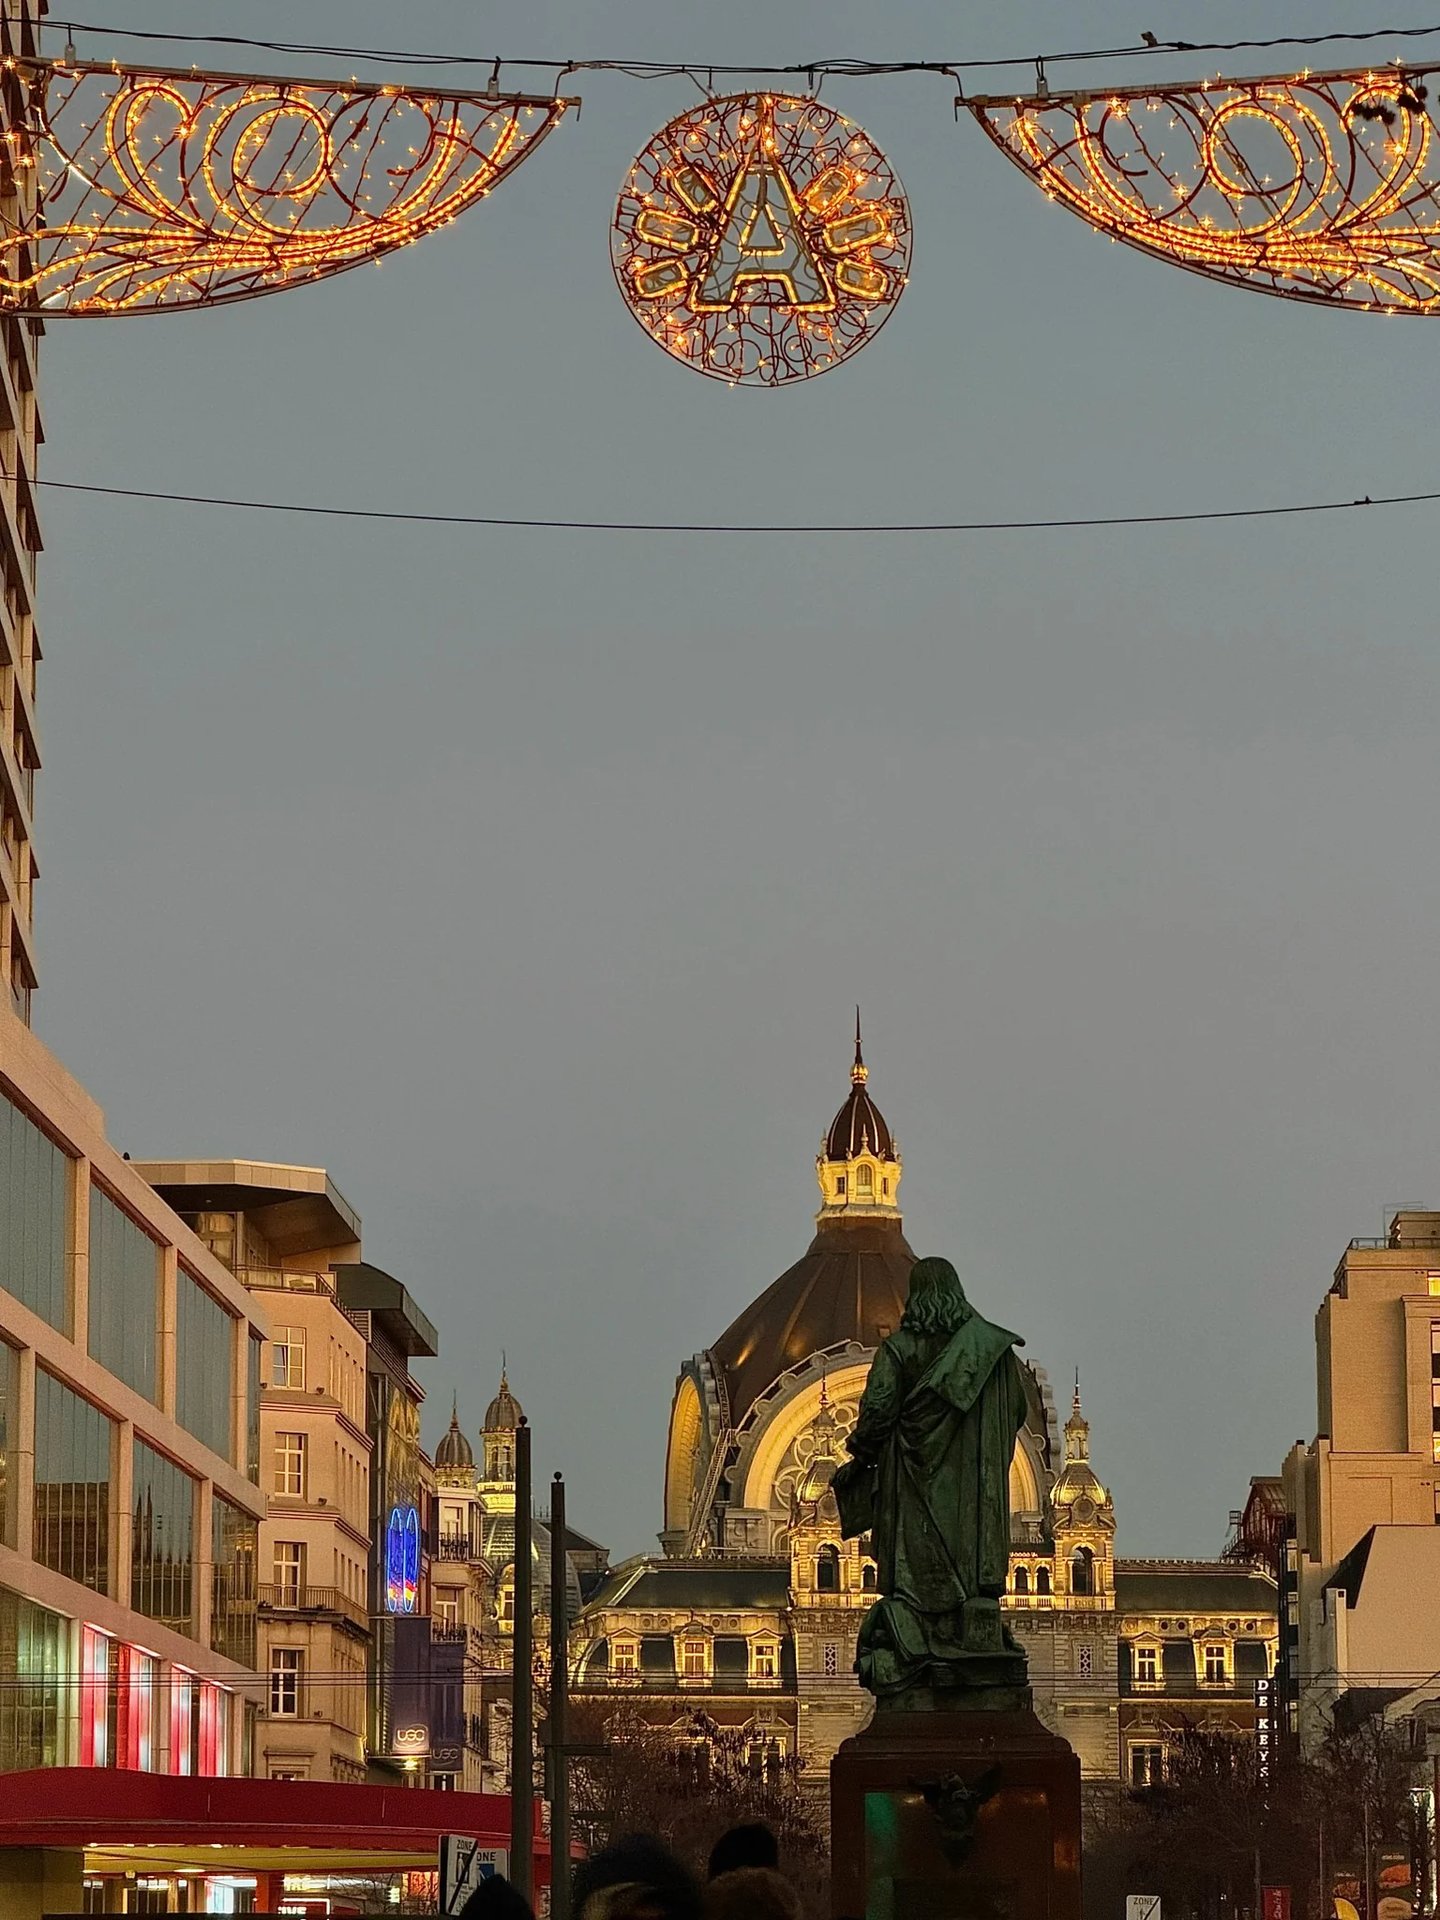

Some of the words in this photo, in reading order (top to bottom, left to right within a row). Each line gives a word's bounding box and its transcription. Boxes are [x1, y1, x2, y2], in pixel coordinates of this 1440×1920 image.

[1258, 1680, 1269, 1707] DE
[397, 1730, 424, 1741] UGC
[1258, 1719, 1269, 1809] KEYS
[457, 1840, 473, 1851] ZONE
[477, 1852, 496, 1861] ONE
[1133, 1897, 1154, 1905] ZONE
